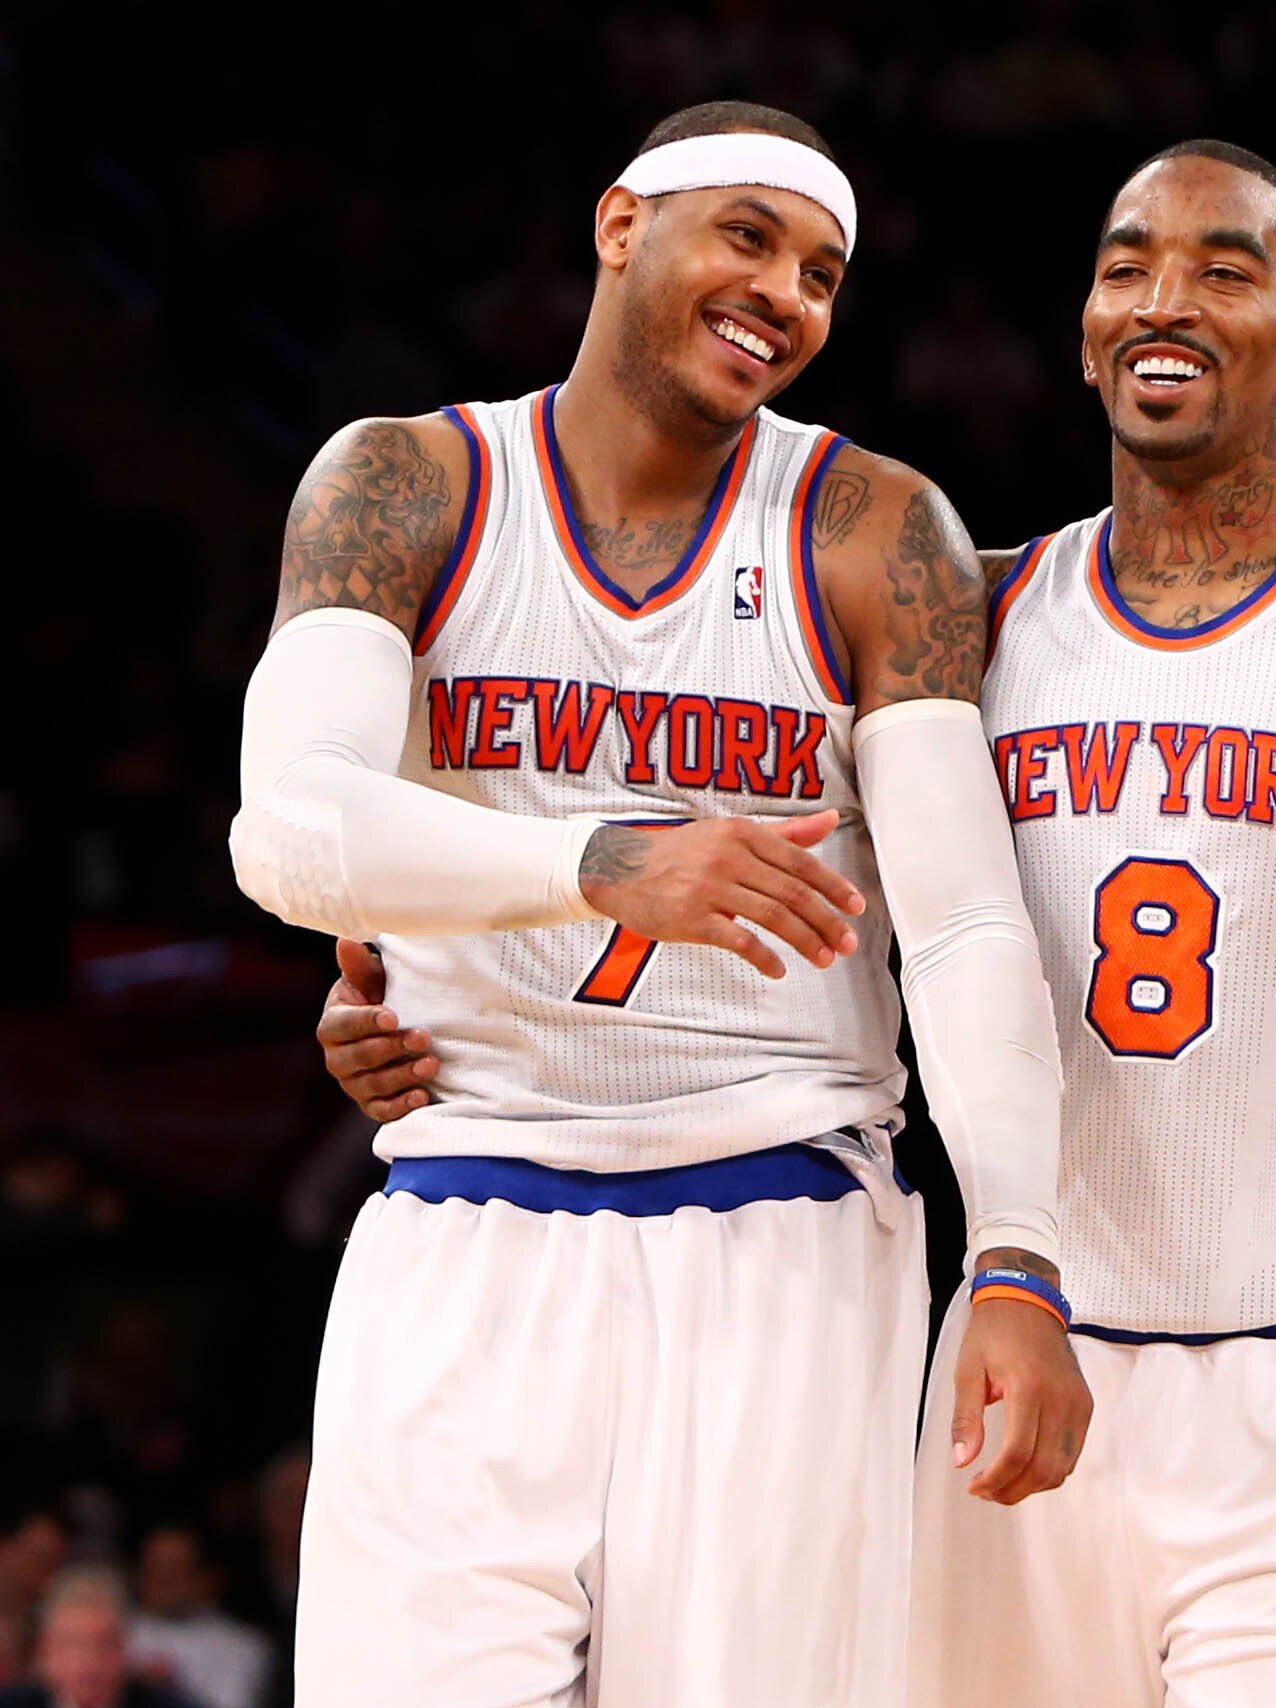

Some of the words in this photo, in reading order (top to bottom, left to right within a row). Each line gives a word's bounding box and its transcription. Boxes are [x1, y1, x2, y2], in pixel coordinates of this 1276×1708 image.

[428, 676, 615, 774] NEW
[616, 691, 827, 799] YORK
[1085, 855, 1221, 1059] 8
